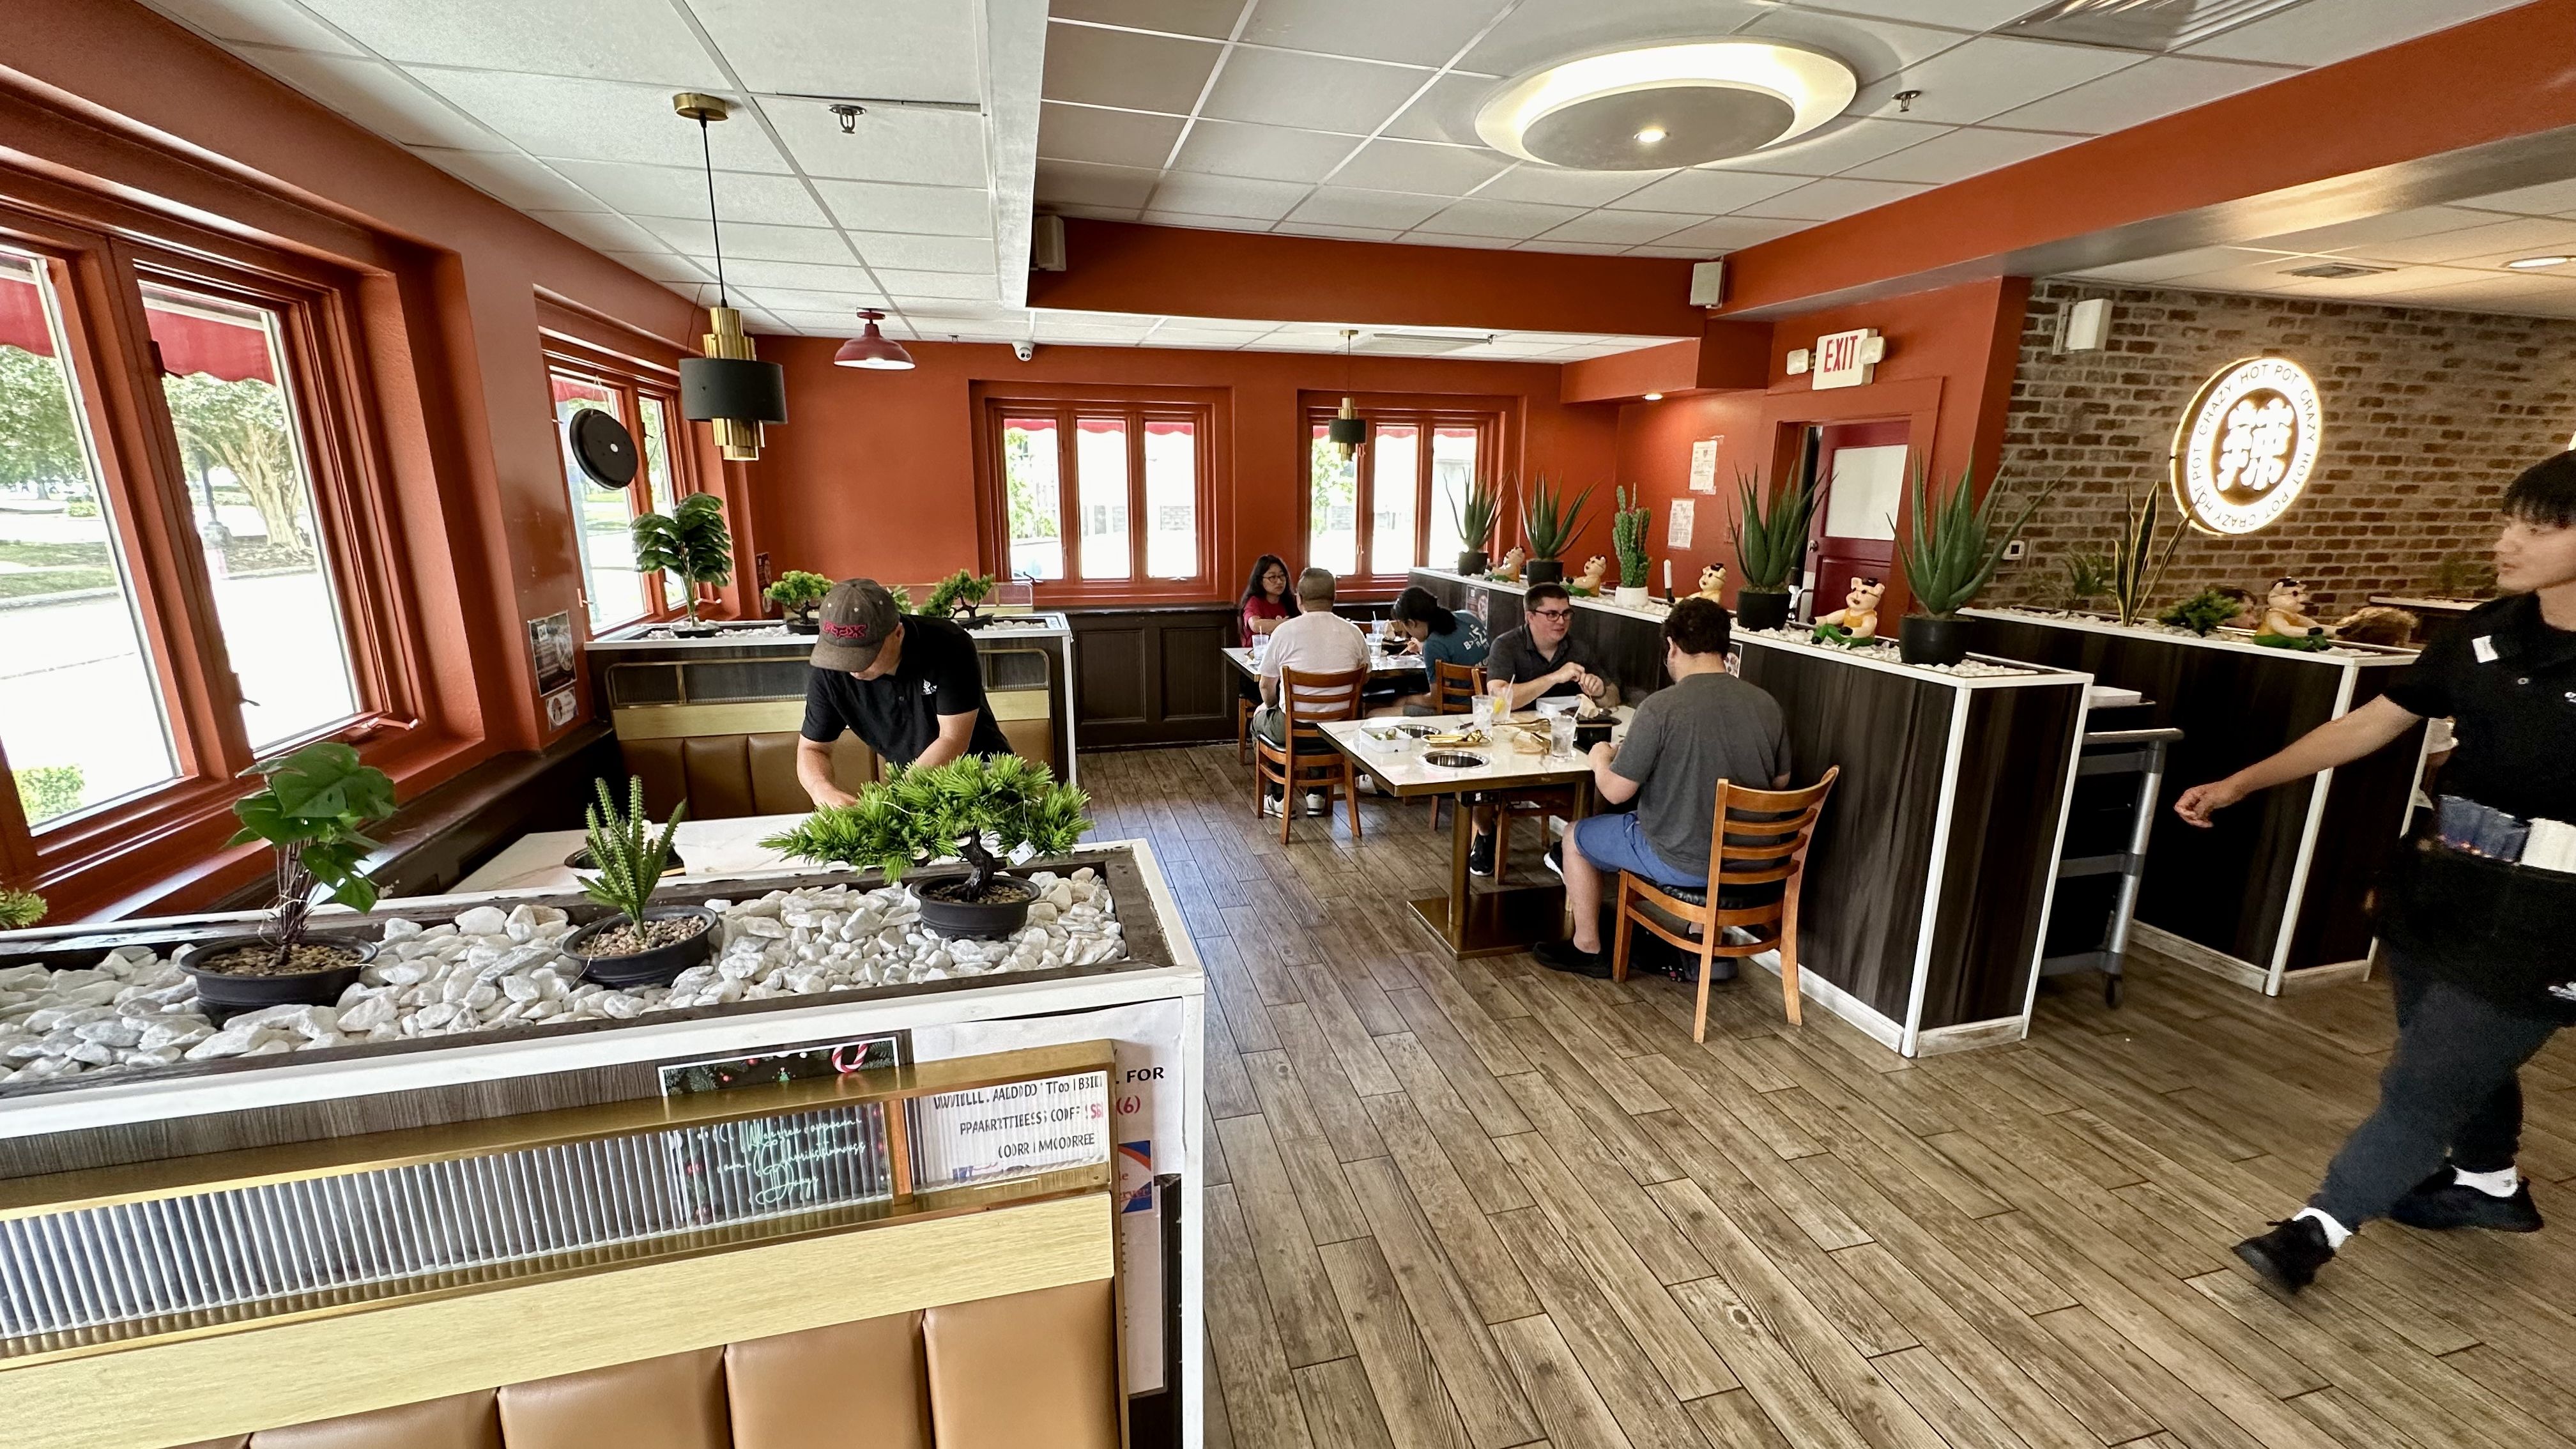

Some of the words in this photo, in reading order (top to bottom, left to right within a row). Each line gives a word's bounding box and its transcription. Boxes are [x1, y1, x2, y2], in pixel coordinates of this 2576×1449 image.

[1823, 335, 1858, 372] EXIT
[2199, 383, 2232, 435] CRAZY
[2241, 364, 2269, 384] HOT
[2274, 365, 2299, 384] POT
[2300, 389, 2316, 442] CRAZY
[2192, 448, 2202, 480] POT
[2292, 453, 2312, 486] HOT
[2214, 512, 2256, 528] CRAZY
[2265, 491, 2288, 519] POT
[1126, 1067, 1165, 1083] FOR
[1116, 1096, 1141, 1116] (6)
